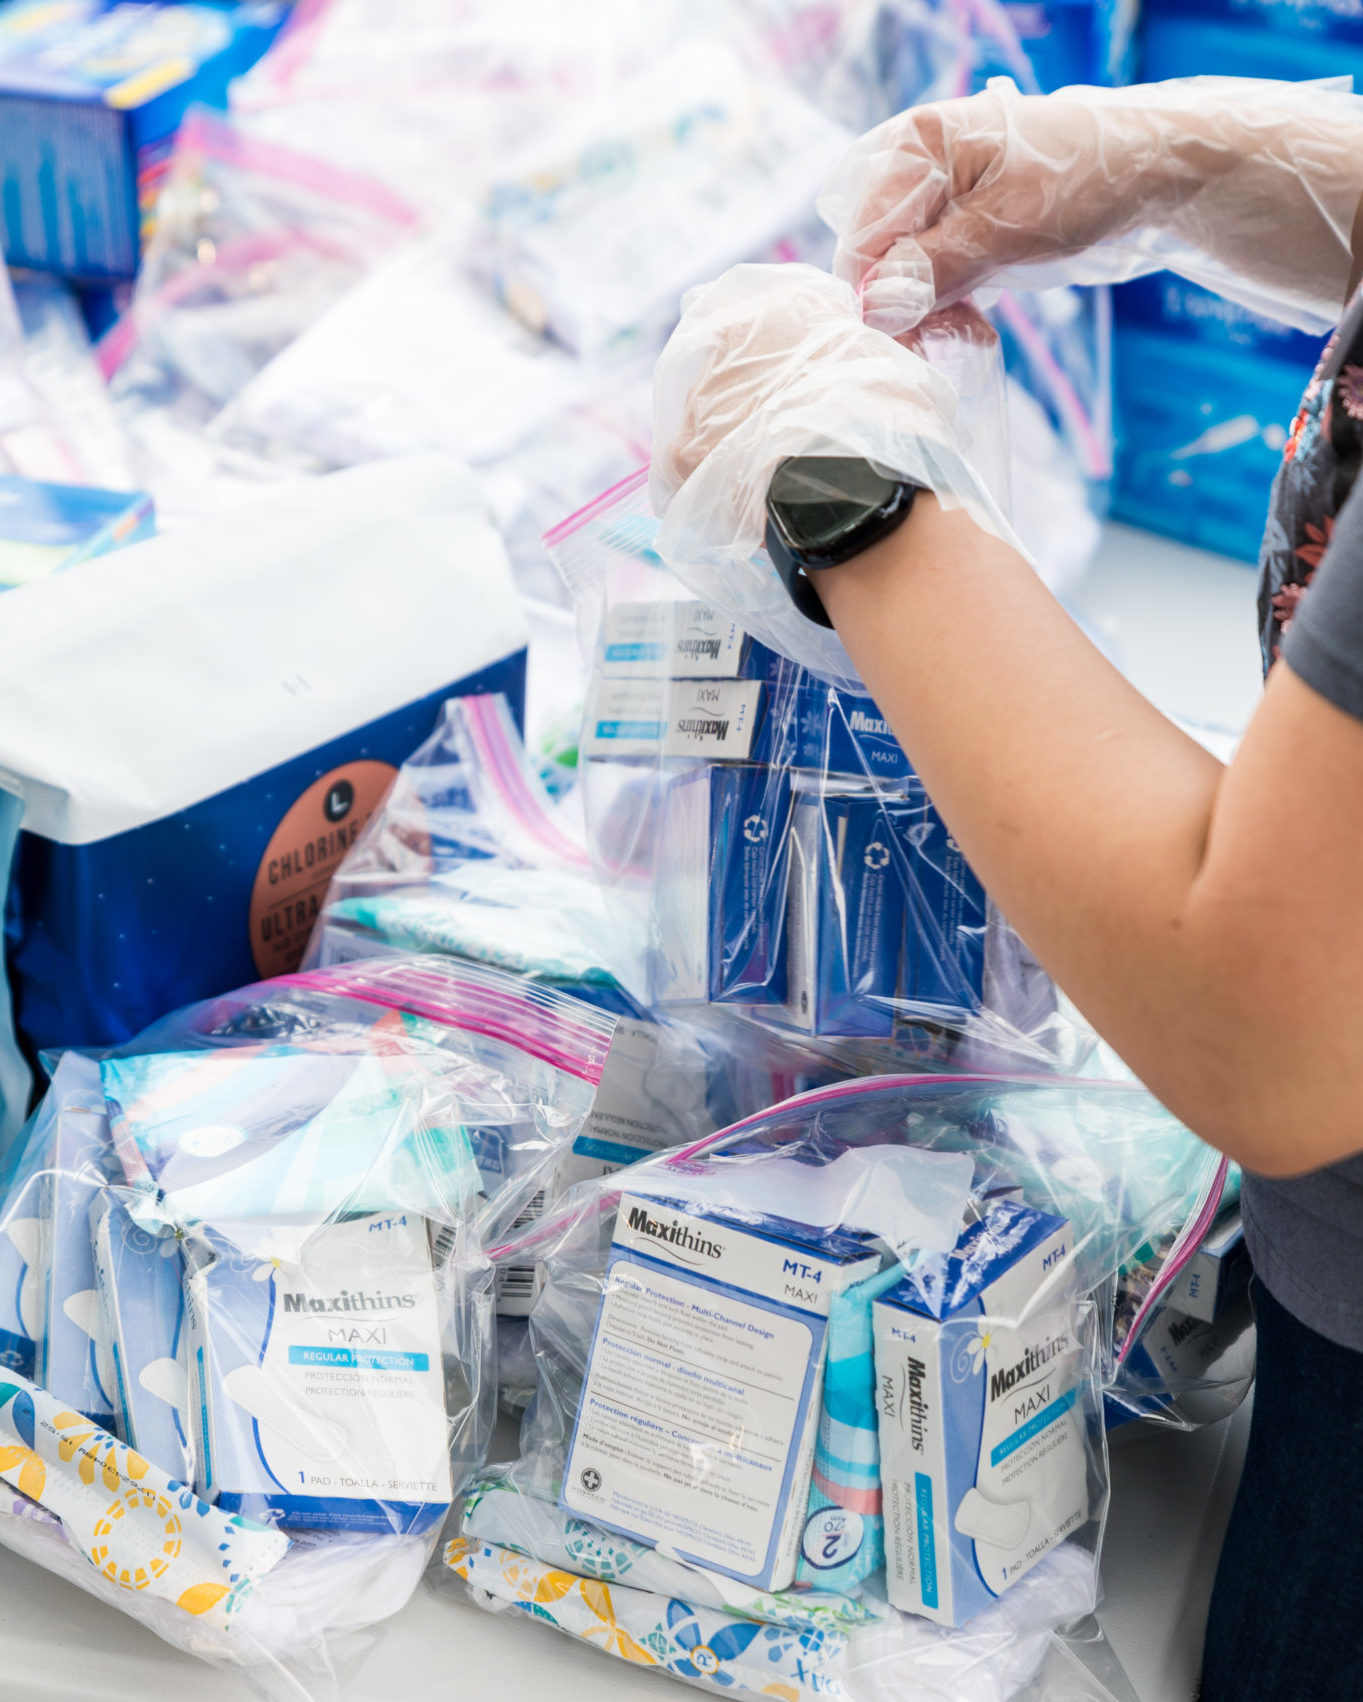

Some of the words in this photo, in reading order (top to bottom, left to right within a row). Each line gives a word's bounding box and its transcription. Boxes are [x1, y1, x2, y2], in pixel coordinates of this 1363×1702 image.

[677, 639, 722, 661] Maxithins
[697, 689, 719, 702] MAXI
[676, 719, 729, 741] Maxithins
[871, 751, 899, 764] MAXI
[332, 792, 348, 813] L
[261, 893, 319, 942] ULTRA
[368, 1215, 408, 1232] MT-4
[628, 1207, 723, 1259] Maxithins
[1042, 1243, 1066, 1272] MT-4
[782, 1259, 823, 1284] MT-4
[784, 1283, 819, 1304] MAXI
[1188, 1273, 1201, 1299] MT-4
[283, 1289, 417, 1313] Maxithins
[645, 1287, 686, 1308] Protection
[691, 1304, 746, 1330] Multi-Channel
[747, 1323, 775, 1340] Design
[328, 1328, 387, 1345] MAXI
[892, 1327, 917, 1343] MT-4
[302, 1350, 348, 1362] REGULAR
[351, 1353, 415, 1366] PROTECTION
[990, 1333, 1069, 1403] Maxithins
[643, 1351, 671, 1370] normal
[704, 1374, 745, 1397] multicanal
[882, 1375, 896, 1417] MAXI
[907, 1356, 932, 1451] Maxithins
[1014, 1384, 1051, 1425] MAXI
[590, 1397, 629, 1420] Protection
[630, 1412, 664, 1435] régulière
[298, 1471, 305, 1484] 1
[310, 1476, 331, 1485] PAD
[340, 1478, 378, 1488] TOALLA
[388, 1480, 438, 1491] SERVIETTE
[822, 1535, 841, 1559] 2
[1002, 1567, 1008, 1581] 1
[1009, 1559, 1023, 1575] PAD
[1025, 1537, 1050, 1561] TOALLA
[922, 1532, 932, 1593] PROTECTION
